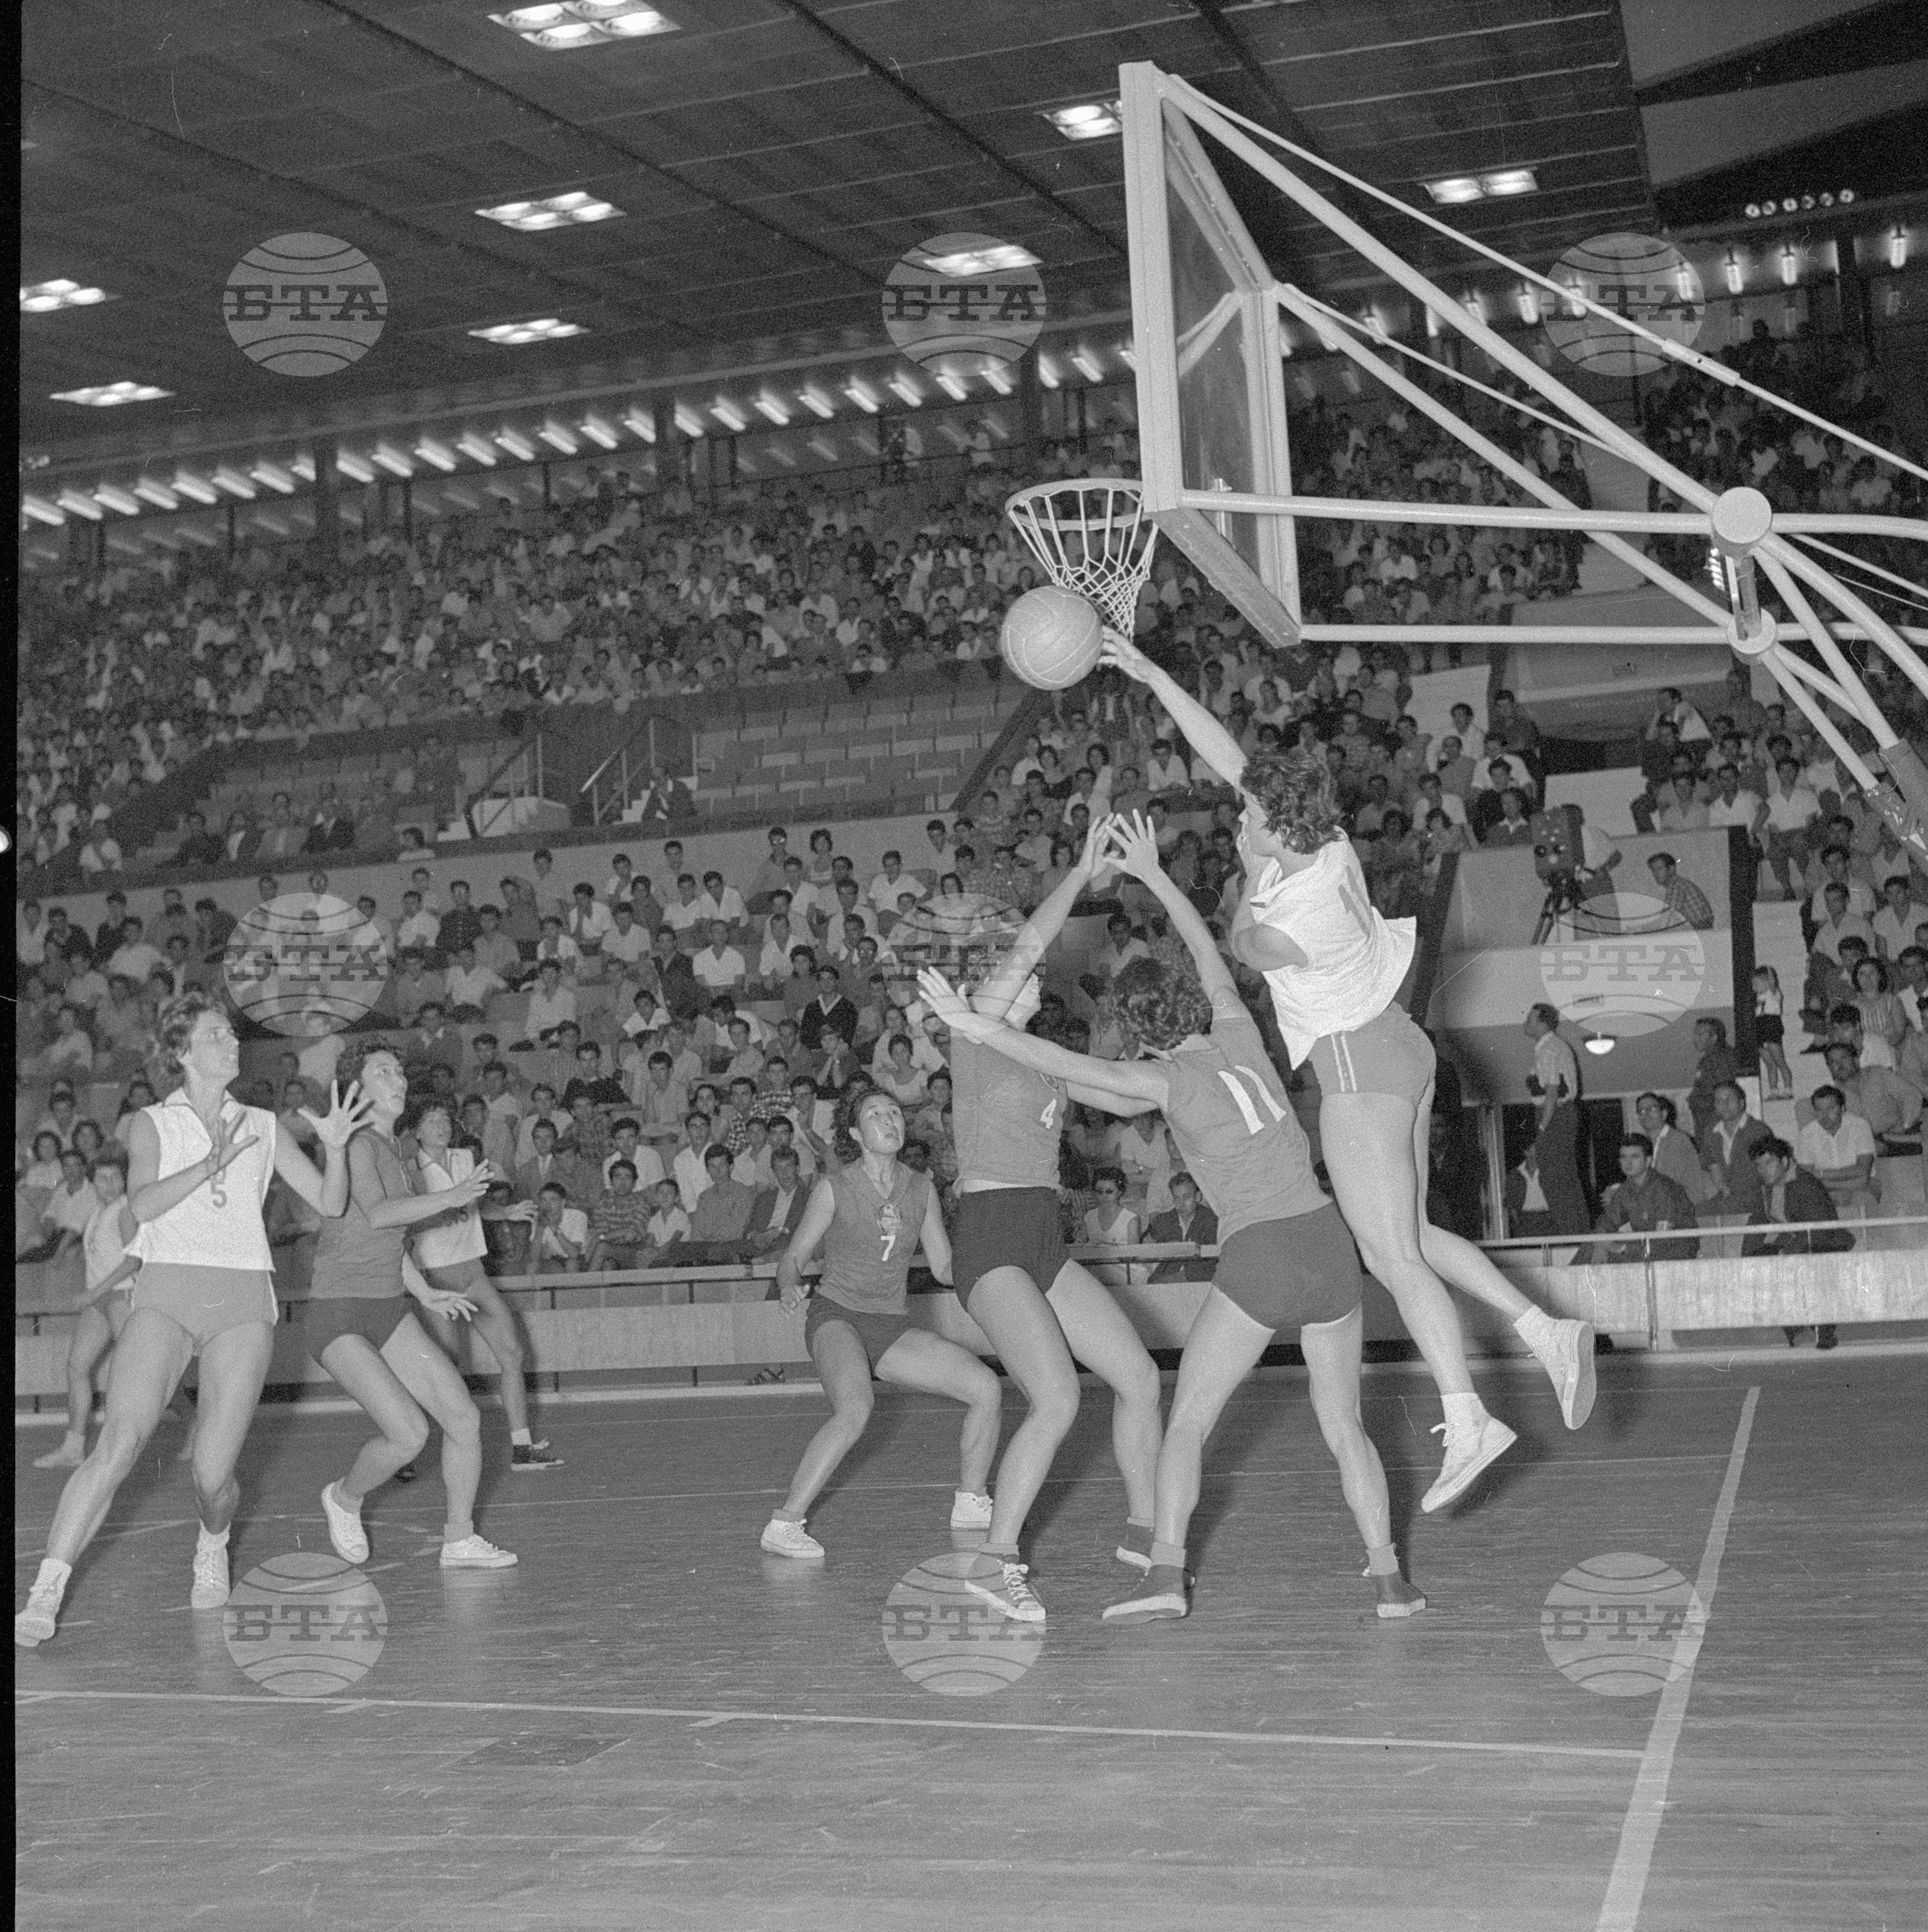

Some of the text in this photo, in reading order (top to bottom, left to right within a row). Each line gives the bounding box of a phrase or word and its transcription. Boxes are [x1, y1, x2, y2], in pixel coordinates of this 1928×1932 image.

[1040, 1097, 1057, 1129] 4
[1218, 1065, 1287, 1135] 11
[210, 1178, 227, 1208] 5
[880, 1234, 895, 1261] 7
